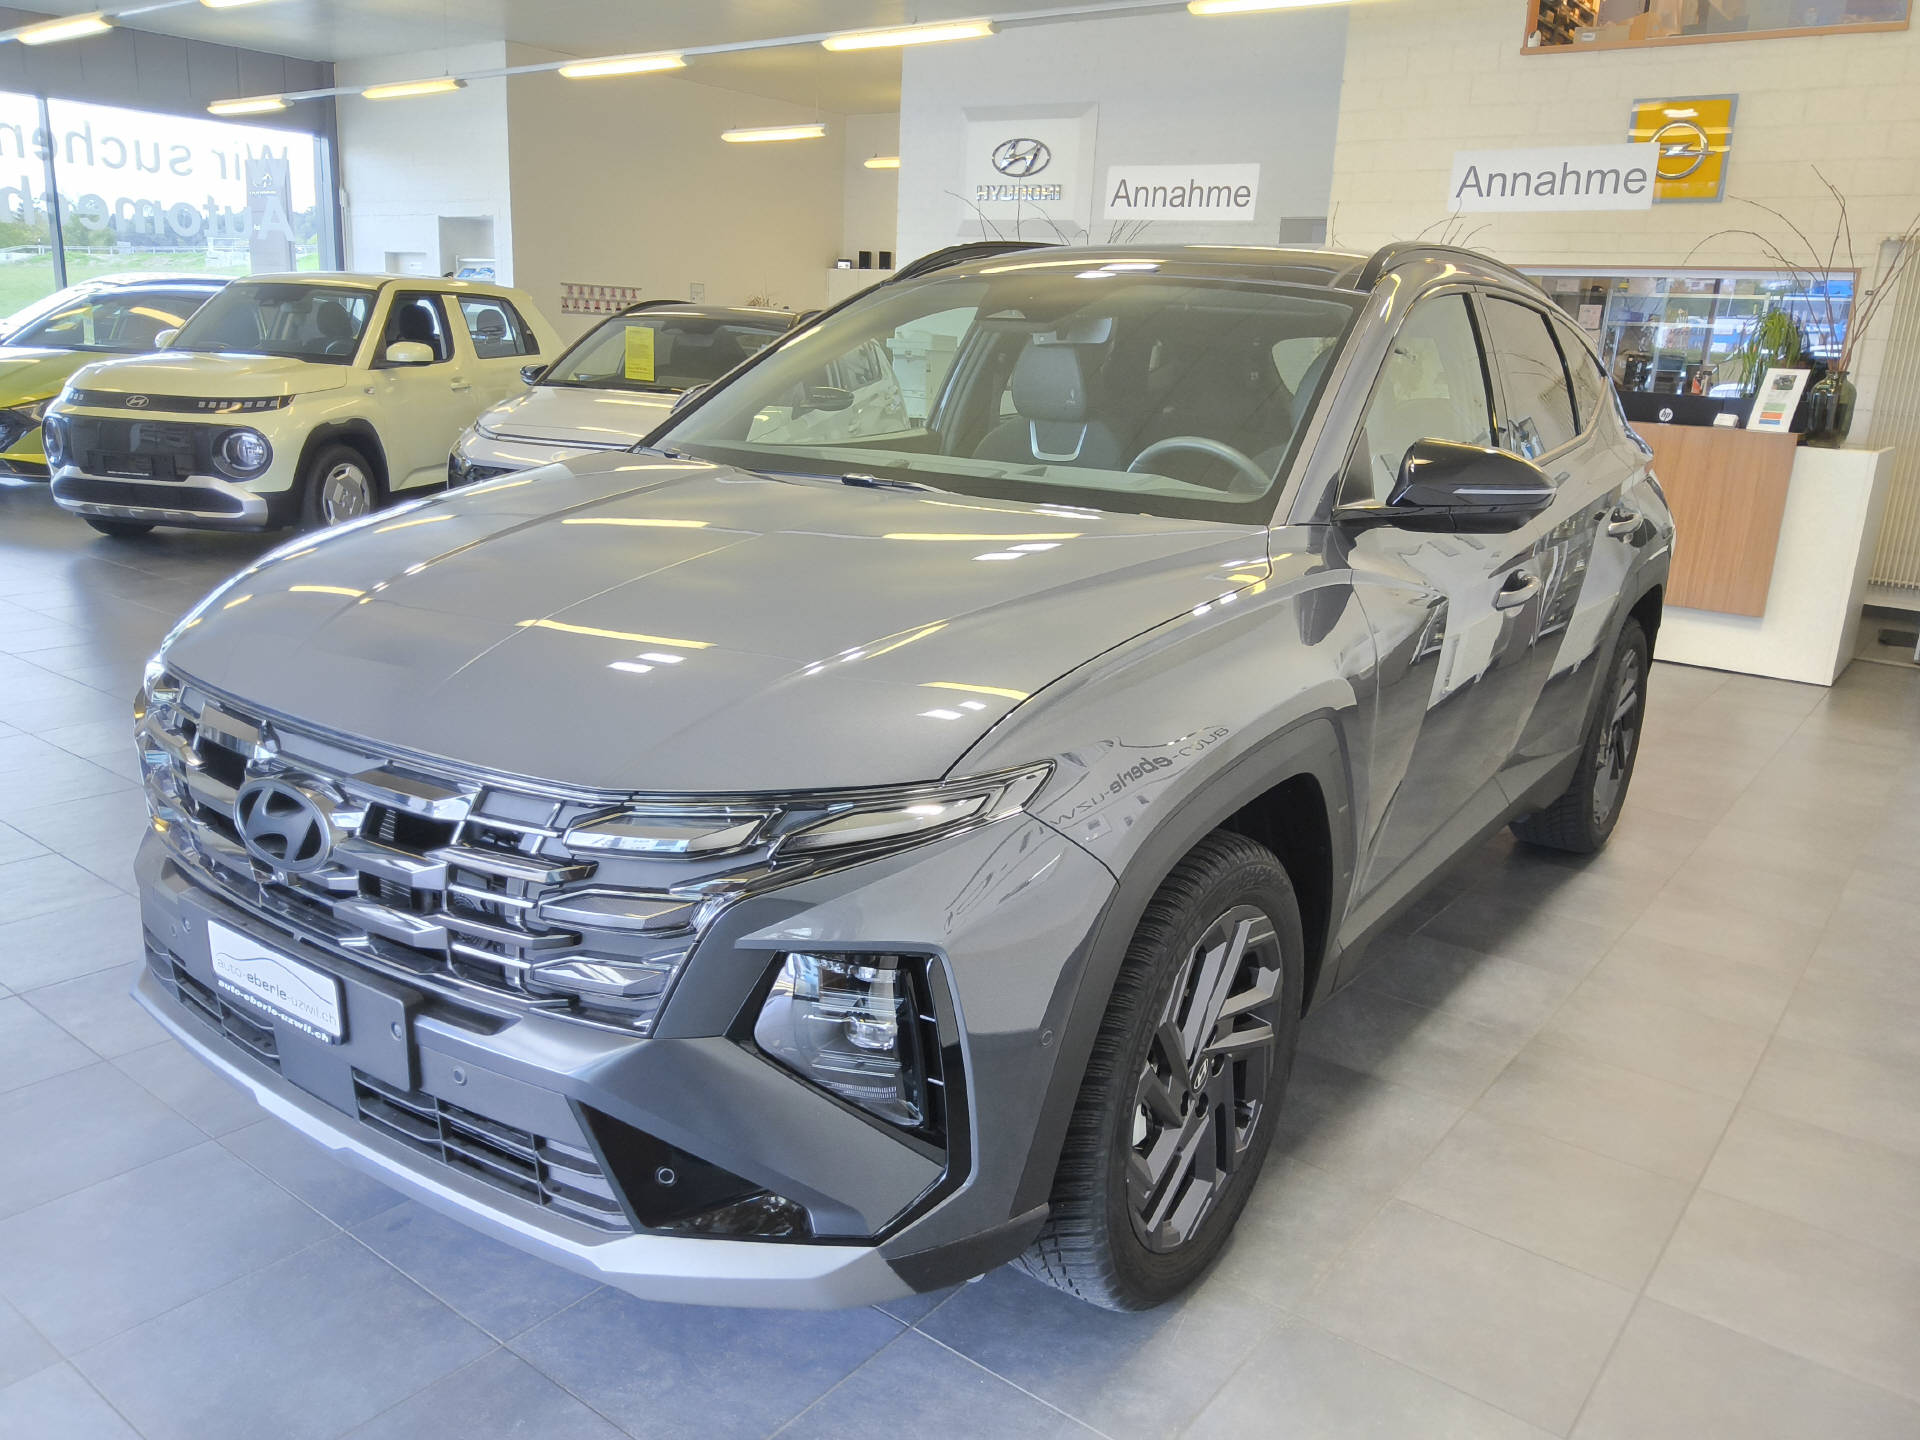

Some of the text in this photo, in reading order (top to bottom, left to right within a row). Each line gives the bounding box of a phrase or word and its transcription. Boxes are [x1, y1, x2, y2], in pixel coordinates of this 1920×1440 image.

[976, 184, 1063, 201] HYUNDAI
[1111, 178, 1251, 208] Annahme
[1456, 162, 1647, 198] Annahme
[217, 979, 329, 1043] auto-eberle-uzwil.ch
